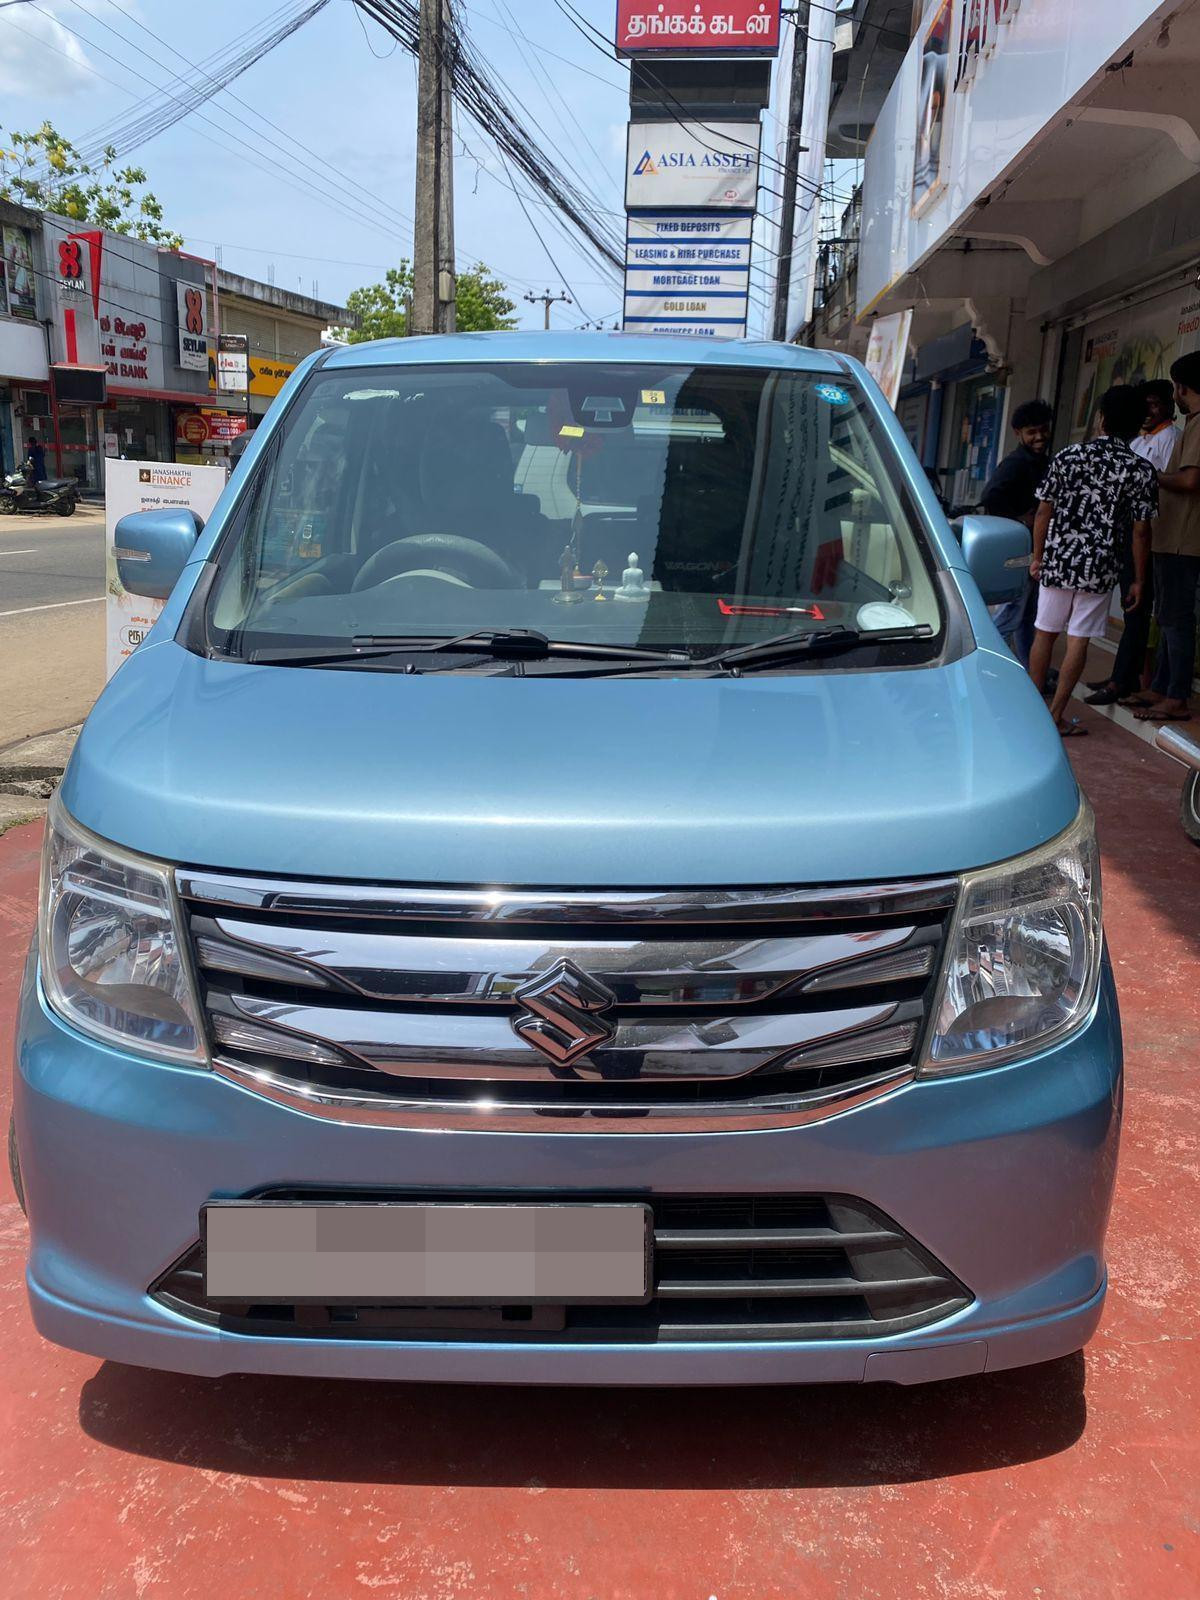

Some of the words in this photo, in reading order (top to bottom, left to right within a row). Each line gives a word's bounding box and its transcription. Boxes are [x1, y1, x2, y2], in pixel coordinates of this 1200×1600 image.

[657, 153, 695, 167] ASIA
[700, 153, 753, 168] ASSET
[656, 222, 679, 232] FIXED
[681, 222, 721, 232] DEPOSITS
[635, 249, 668, 259] LEASING
[669, 250, 675, 259] &
[677, 249, 696, 259] HIRE
[698, 249, 740, 259] PURCHASE
[653, 275, 697, 285] MORTGAGE
[700, 275, 720, 285] LOAN
[664, 301, 684, 311] GOLD
[686, 301, 707, 311] LOAN
[121, 364, 148, 380] BANK
[151, 475, 192, 487] FINANCE
